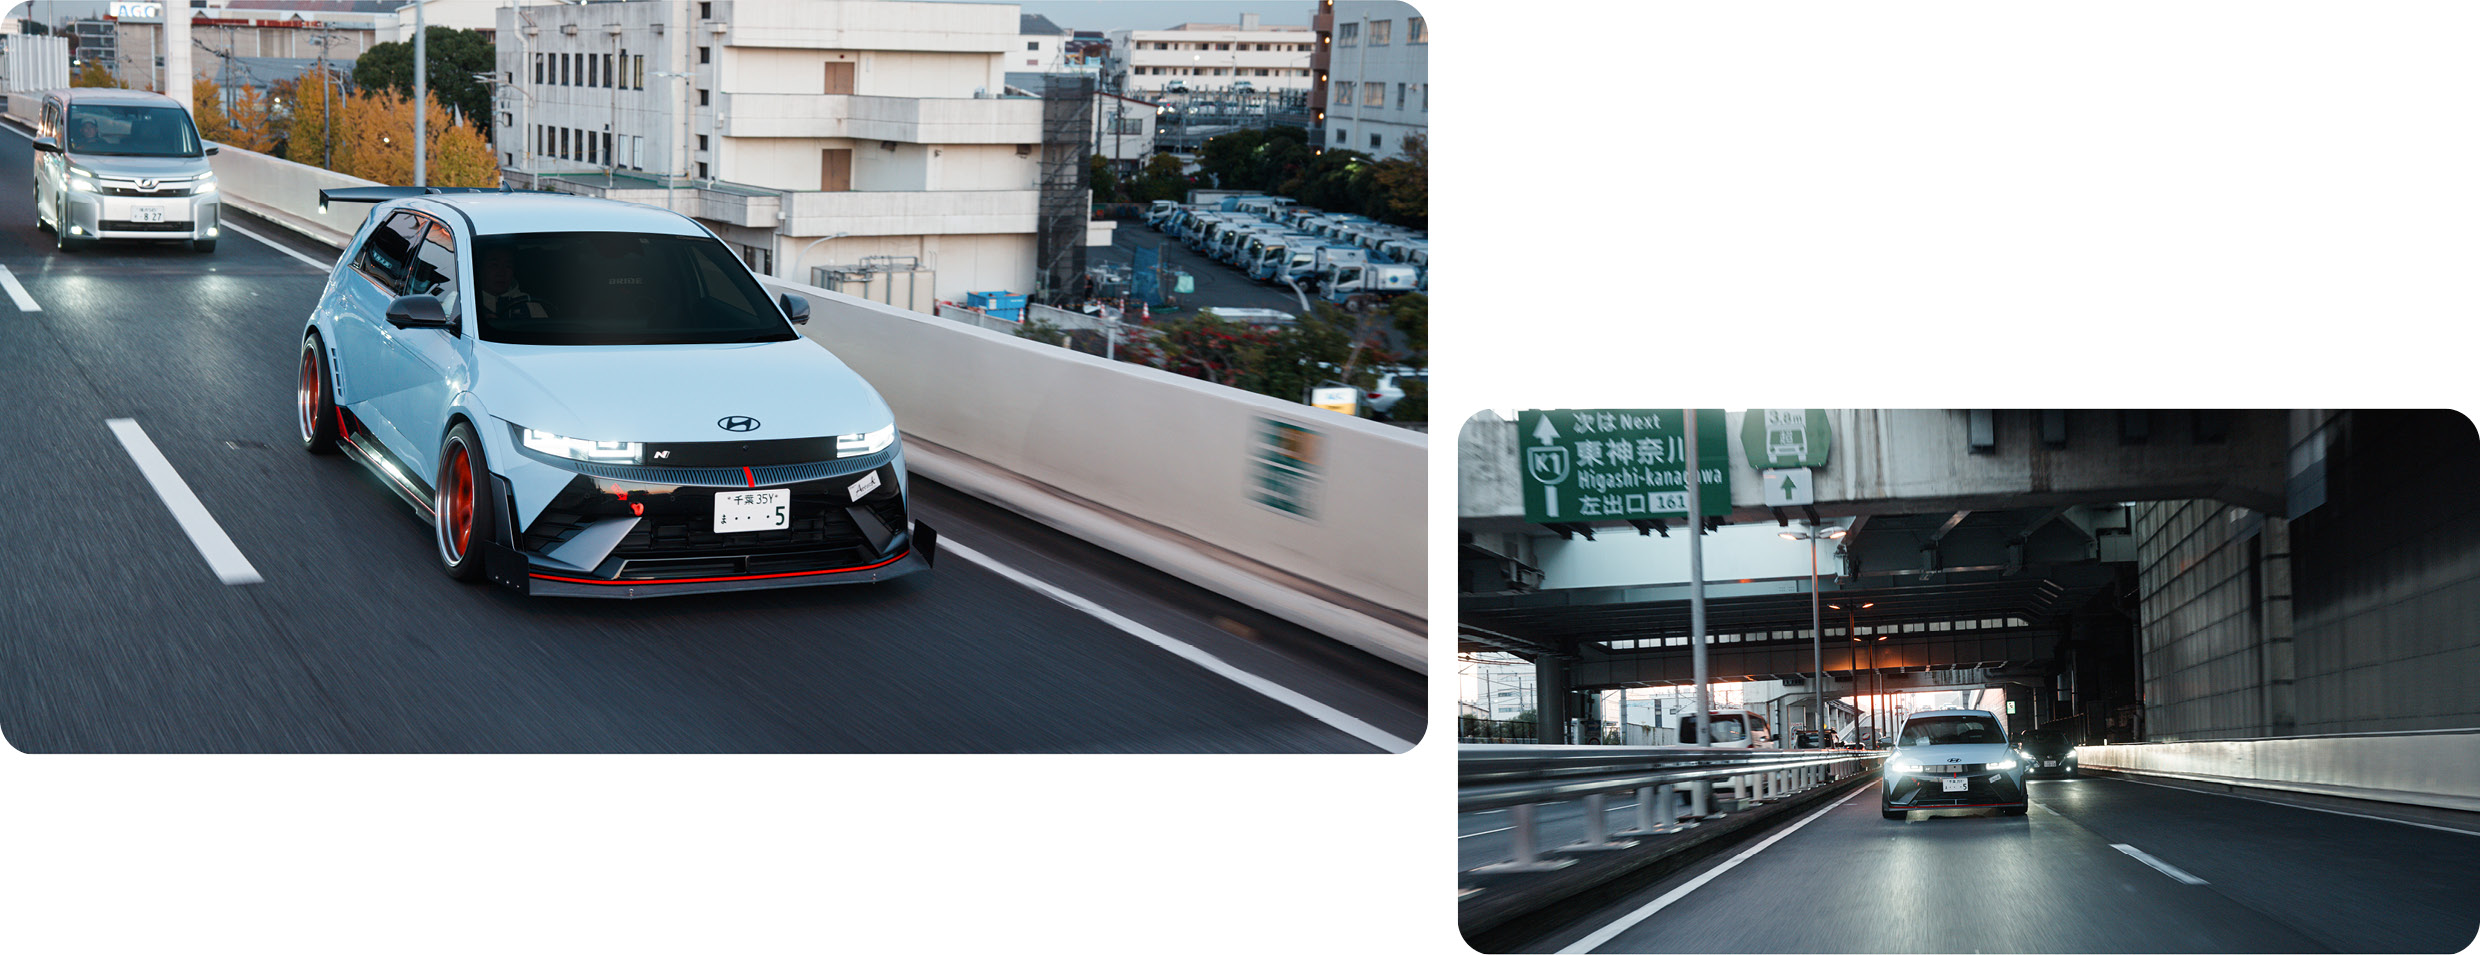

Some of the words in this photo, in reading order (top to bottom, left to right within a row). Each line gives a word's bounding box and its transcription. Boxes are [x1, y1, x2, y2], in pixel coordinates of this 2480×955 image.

[1572, 411, 1617, 434] 次は
[1620, 413, 1662, 431] Next
[1574, 435, 1685, 467] 東神奈川
[1534, 451, 1562, 476] K1
[734, 494, 754, 505] 千葉
[1578, 493, 1647, 516] 左出口
[1656, 493, 1686, 510] 161
